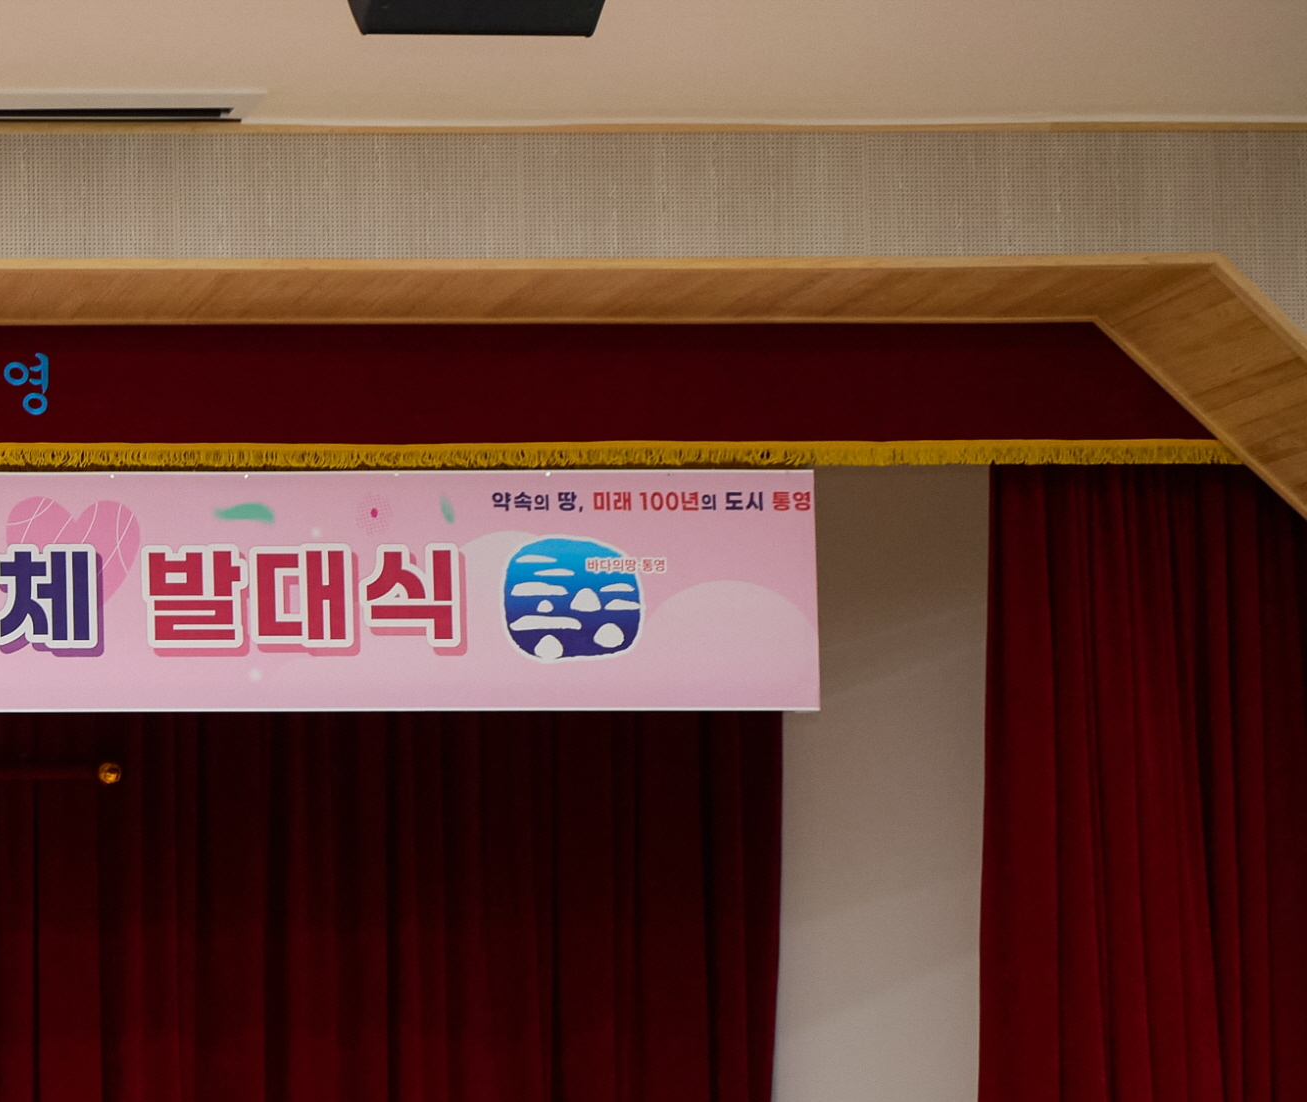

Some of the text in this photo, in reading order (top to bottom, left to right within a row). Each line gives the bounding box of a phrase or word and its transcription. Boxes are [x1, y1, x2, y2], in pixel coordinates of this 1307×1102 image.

[492, 491, 812, 514] 약속의 땅, 미래 100년의 도시 통영
[145, 544, 461, 654] 발대식
